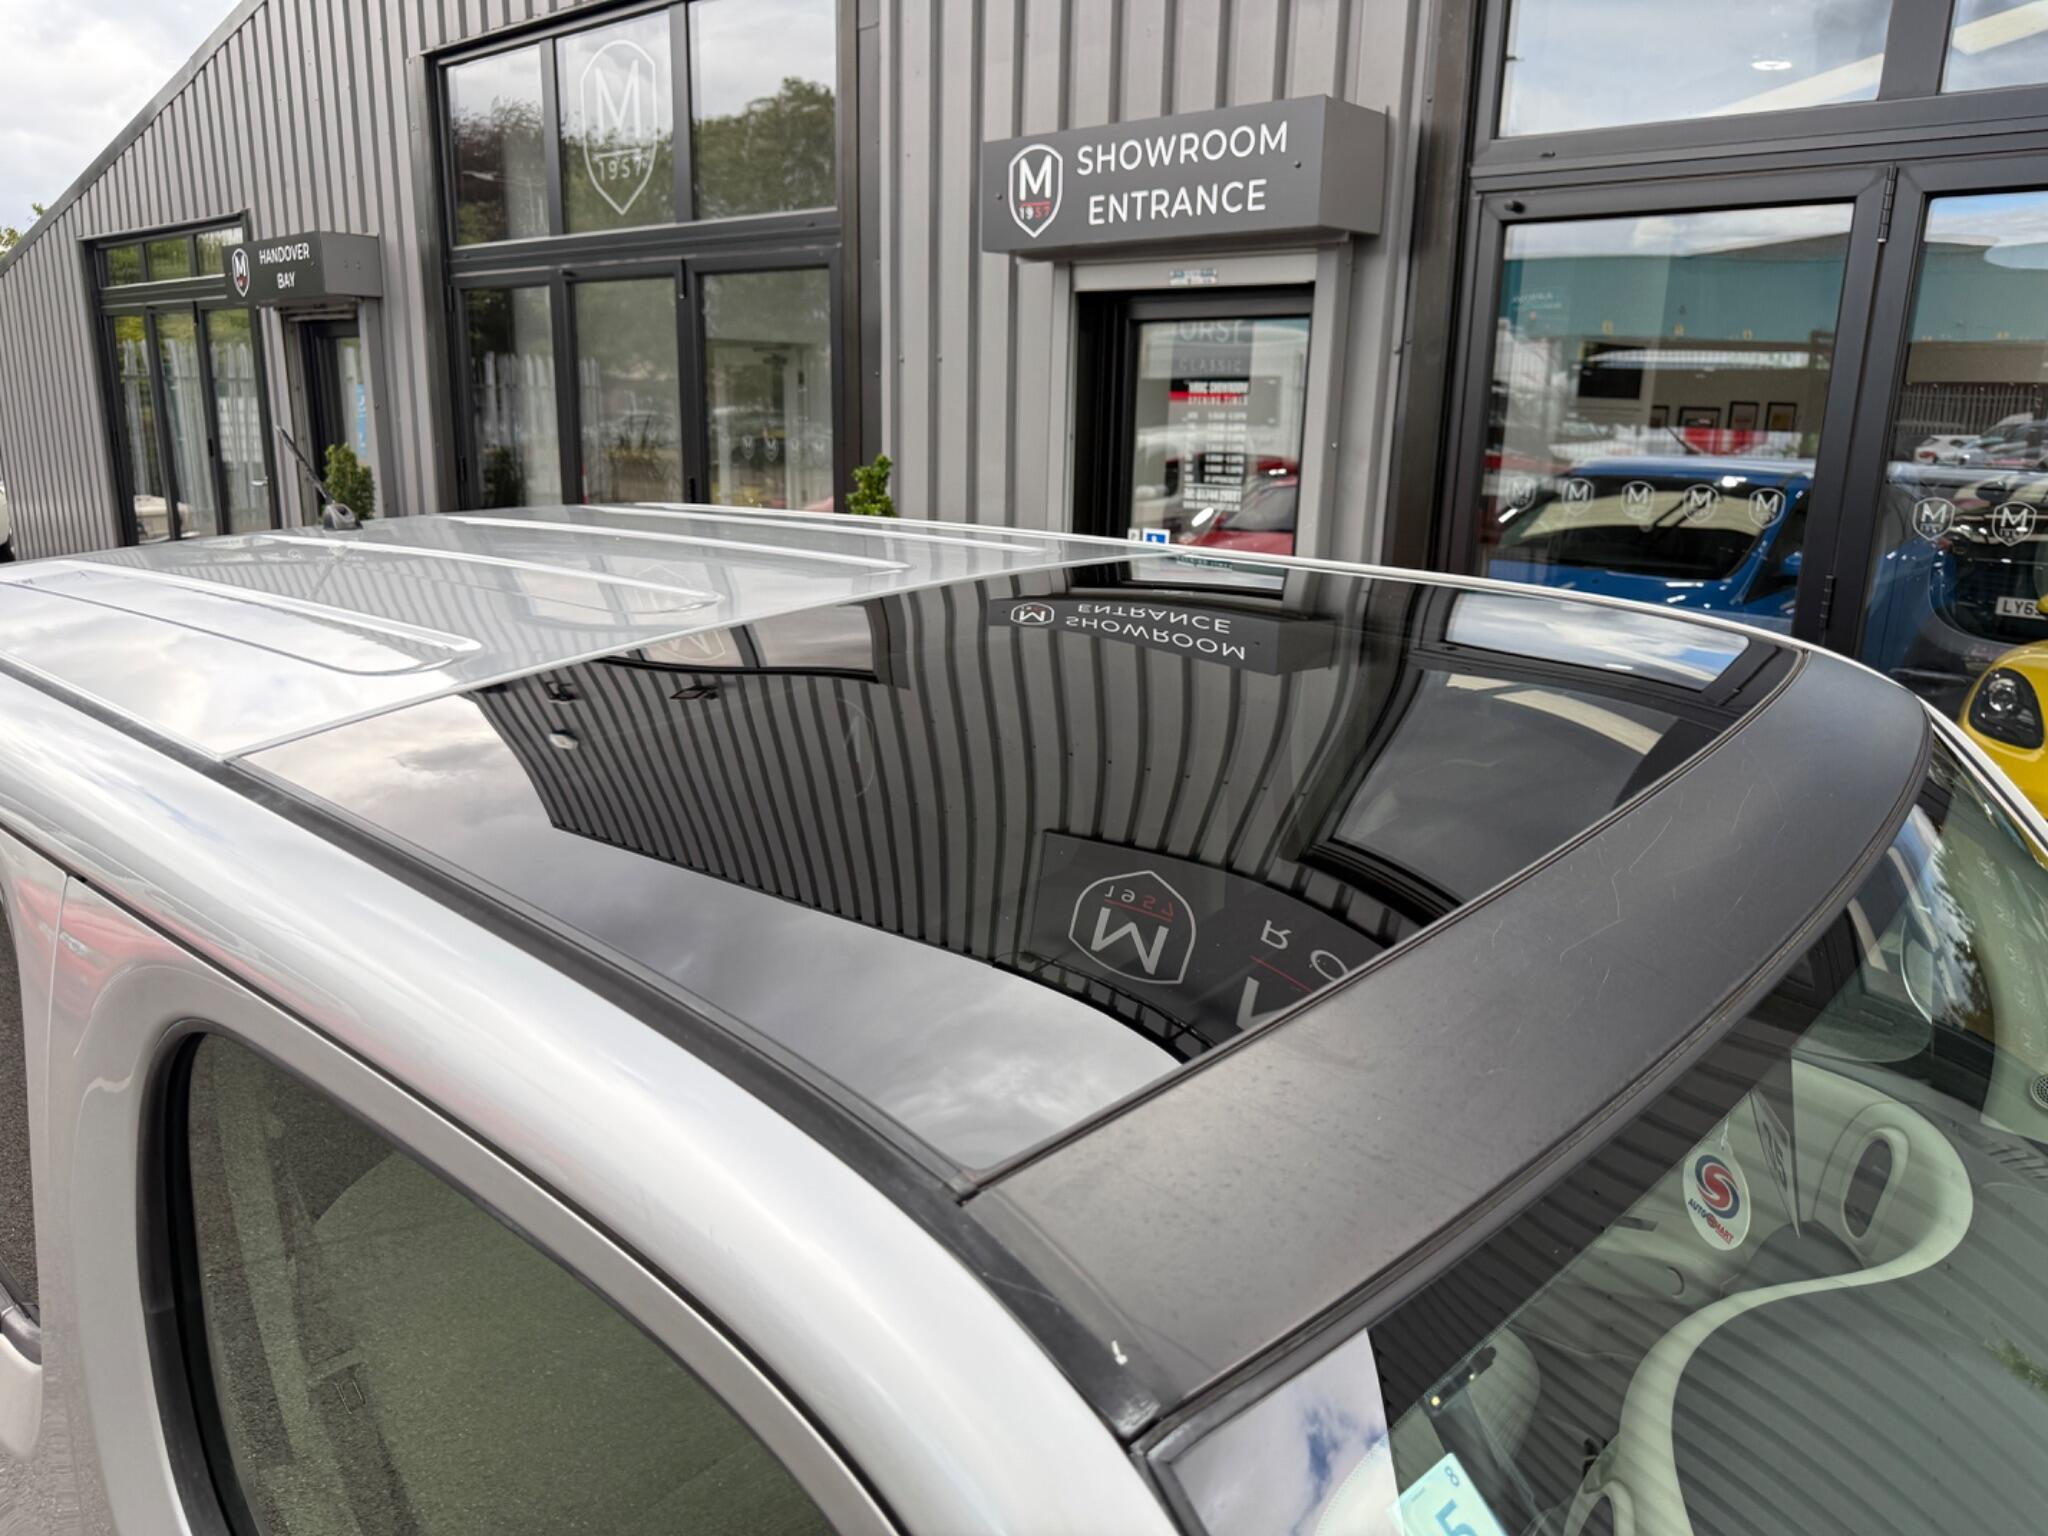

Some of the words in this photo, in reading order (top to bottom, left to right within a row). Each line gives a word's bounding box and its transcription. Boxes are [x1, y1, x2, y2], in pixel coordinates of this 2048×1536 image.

[595, 58, 642, 145] M
[1076, 120, 1289, 176] SHOWROOM
[599, 156, 643, 181] 1957
[1019, 153, 1053, 202] M
[1088, 178, 1268, 226] ENTRANCE
[259, 242, 310, 265] HANDOVER
[276, 271, 296, 289] BAY
[1921, 502, 1948, 523] M
[2001, 507, 2029, 528] M
[2003, 600, 2041, 616] LY6
